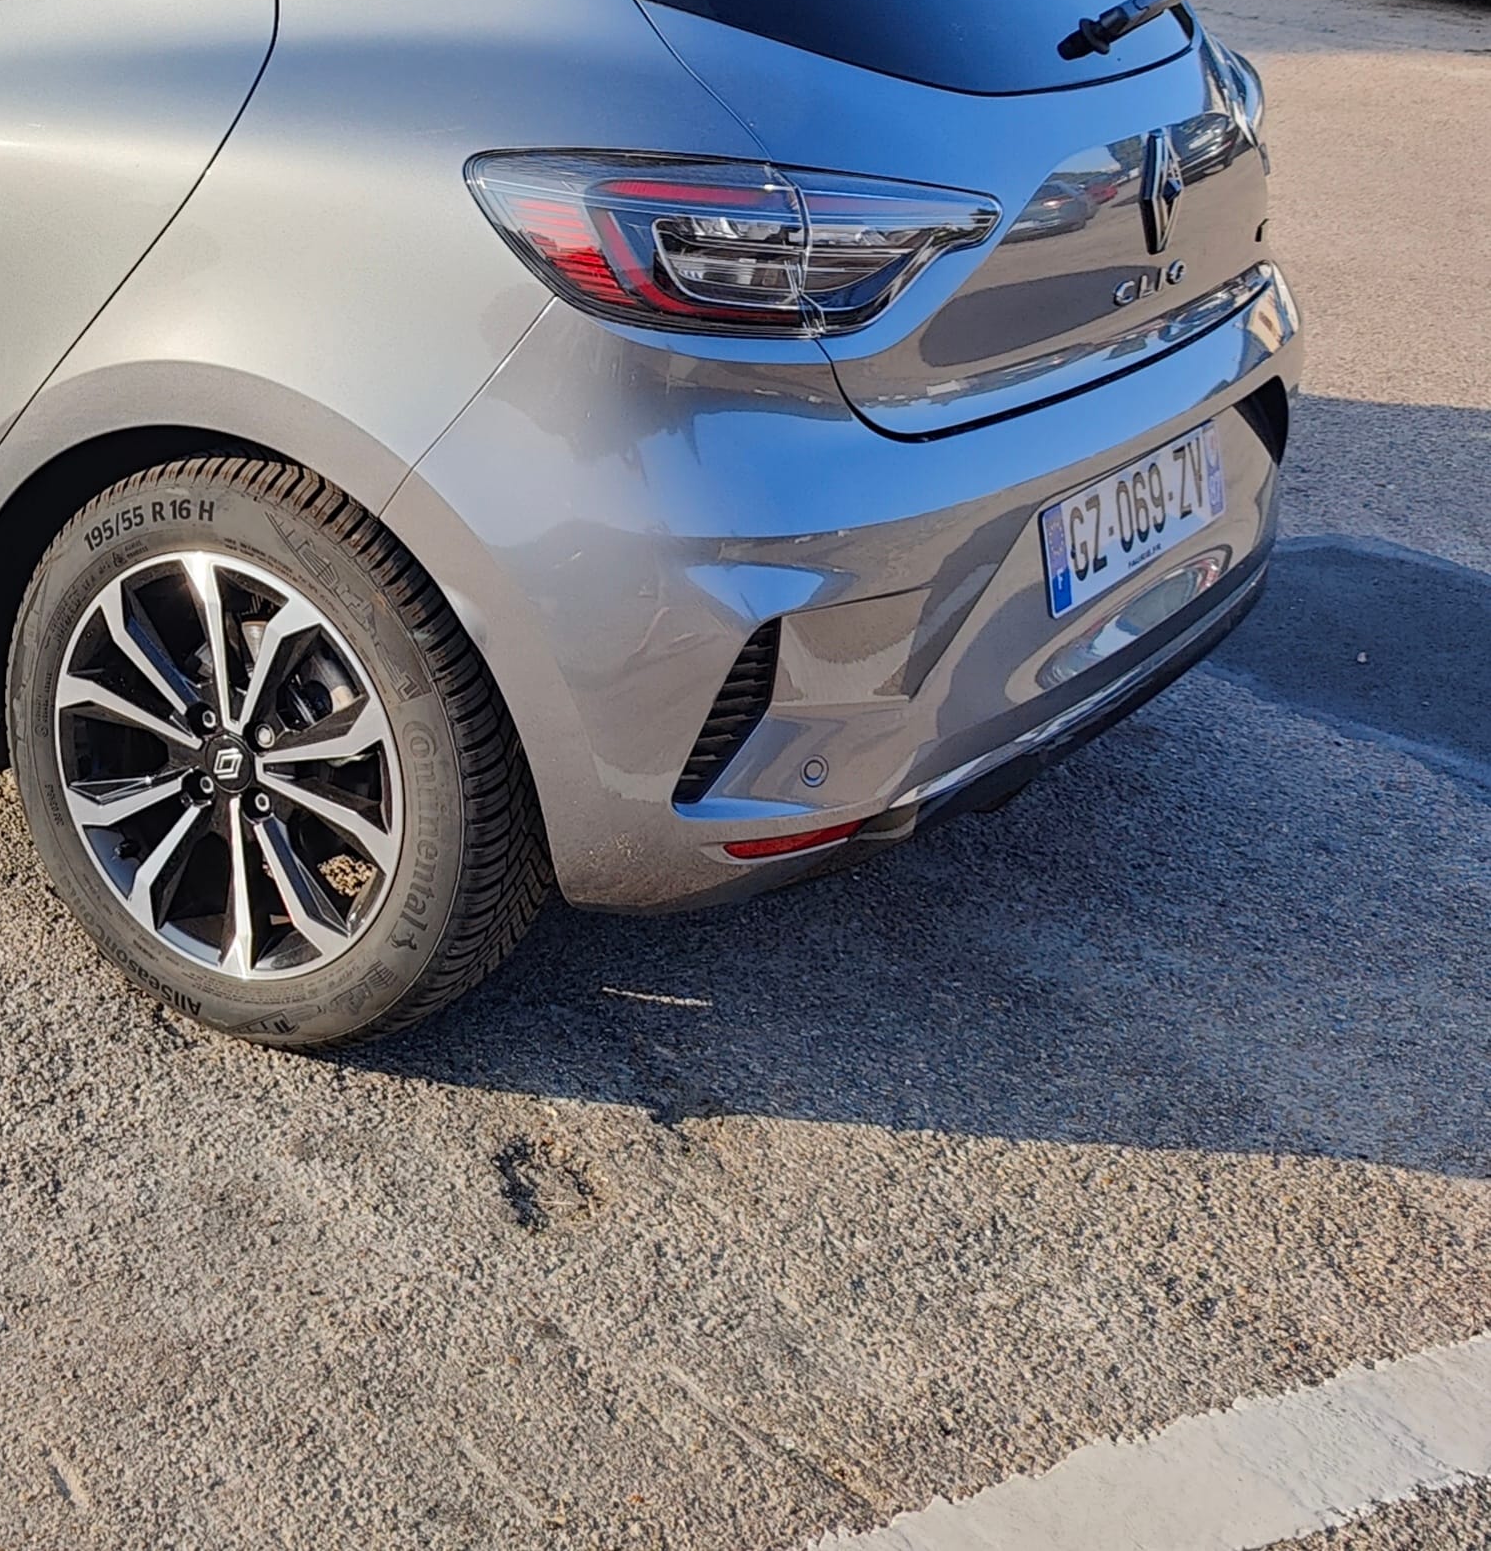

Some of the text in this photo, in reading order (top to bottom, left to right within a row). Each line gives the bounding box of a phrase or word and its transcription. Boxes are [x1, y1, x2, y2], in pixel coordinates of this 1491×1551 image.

[1113, 259, 1187, 307] CLIO
[83, 505, 145, 551] 195/55
[198, 500, 215, 522] H
[401, 720, 440, 932] Continental
